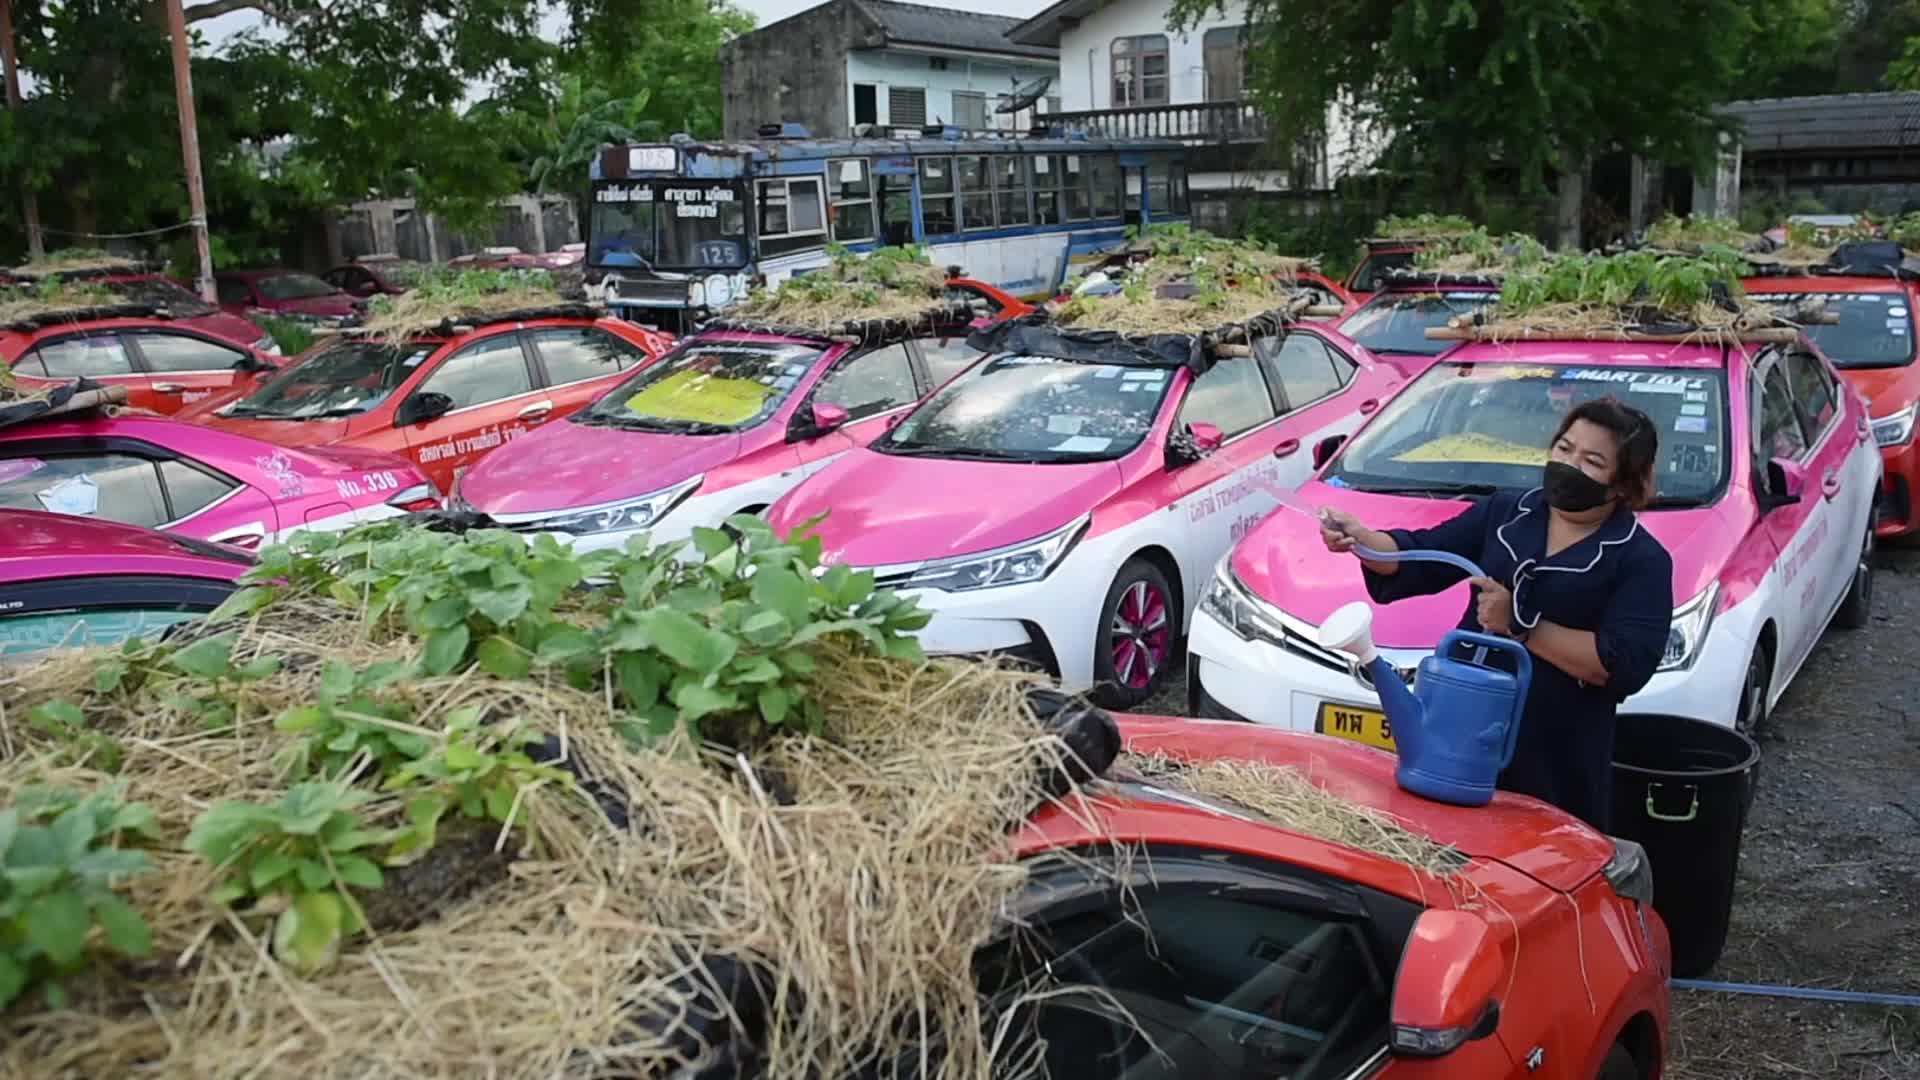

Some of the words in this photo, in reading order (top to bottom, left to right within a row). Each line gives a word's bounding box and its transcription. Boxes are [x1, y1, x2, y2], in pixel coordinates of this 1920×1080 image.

[701, 246, 736, 264] 125
[1561, 368, 1642, 383] SMART
[1648, 373, 1707, 388] TAXI
